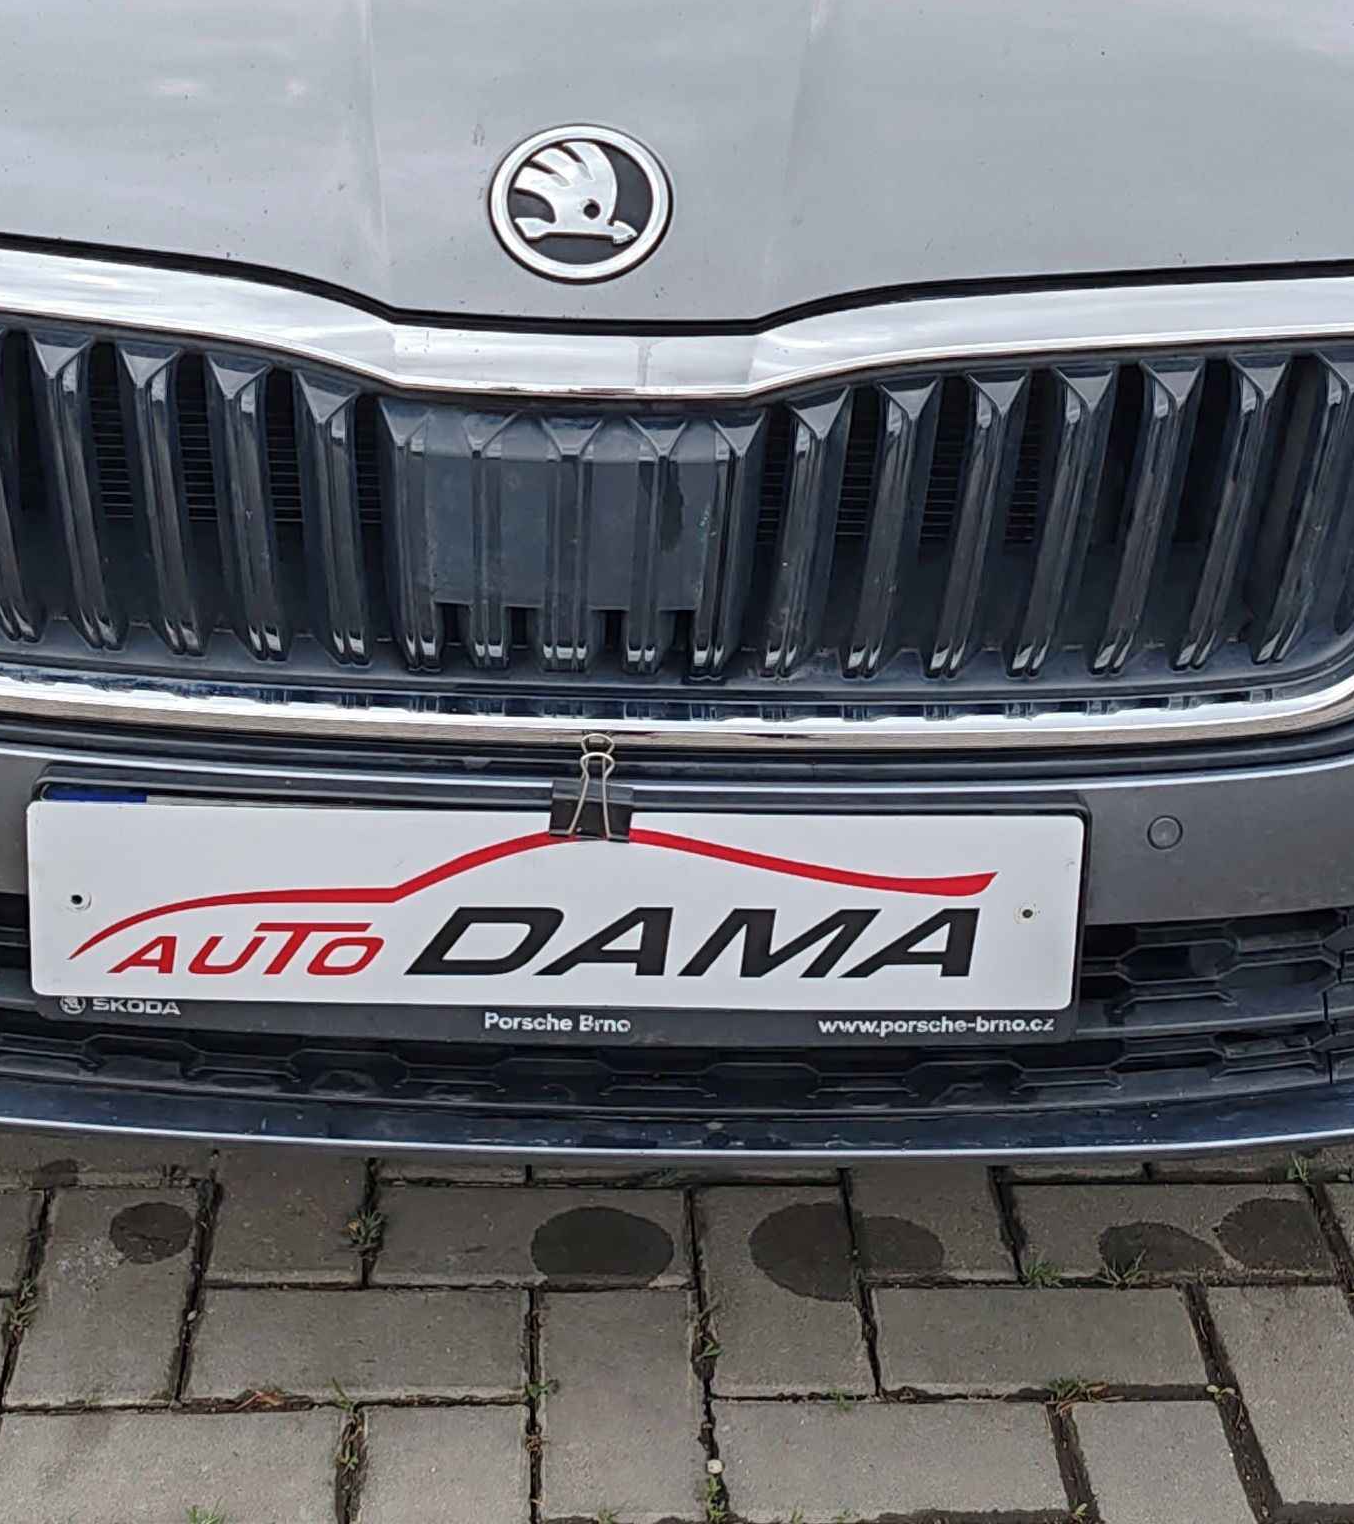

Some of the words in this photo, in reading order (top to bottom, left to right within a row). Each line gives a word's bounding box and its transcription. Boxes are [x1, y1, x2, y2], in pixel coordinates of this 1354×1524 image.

[107, 922, 384, 976] AUTO
[403, 906, 980, 979] DAMA
[484, 1011, 573, 1031] Porsche
[579, 1014, 631, 1033] Brno
[818, 1016, 1054, 1037] www.porsche-brno.cz
